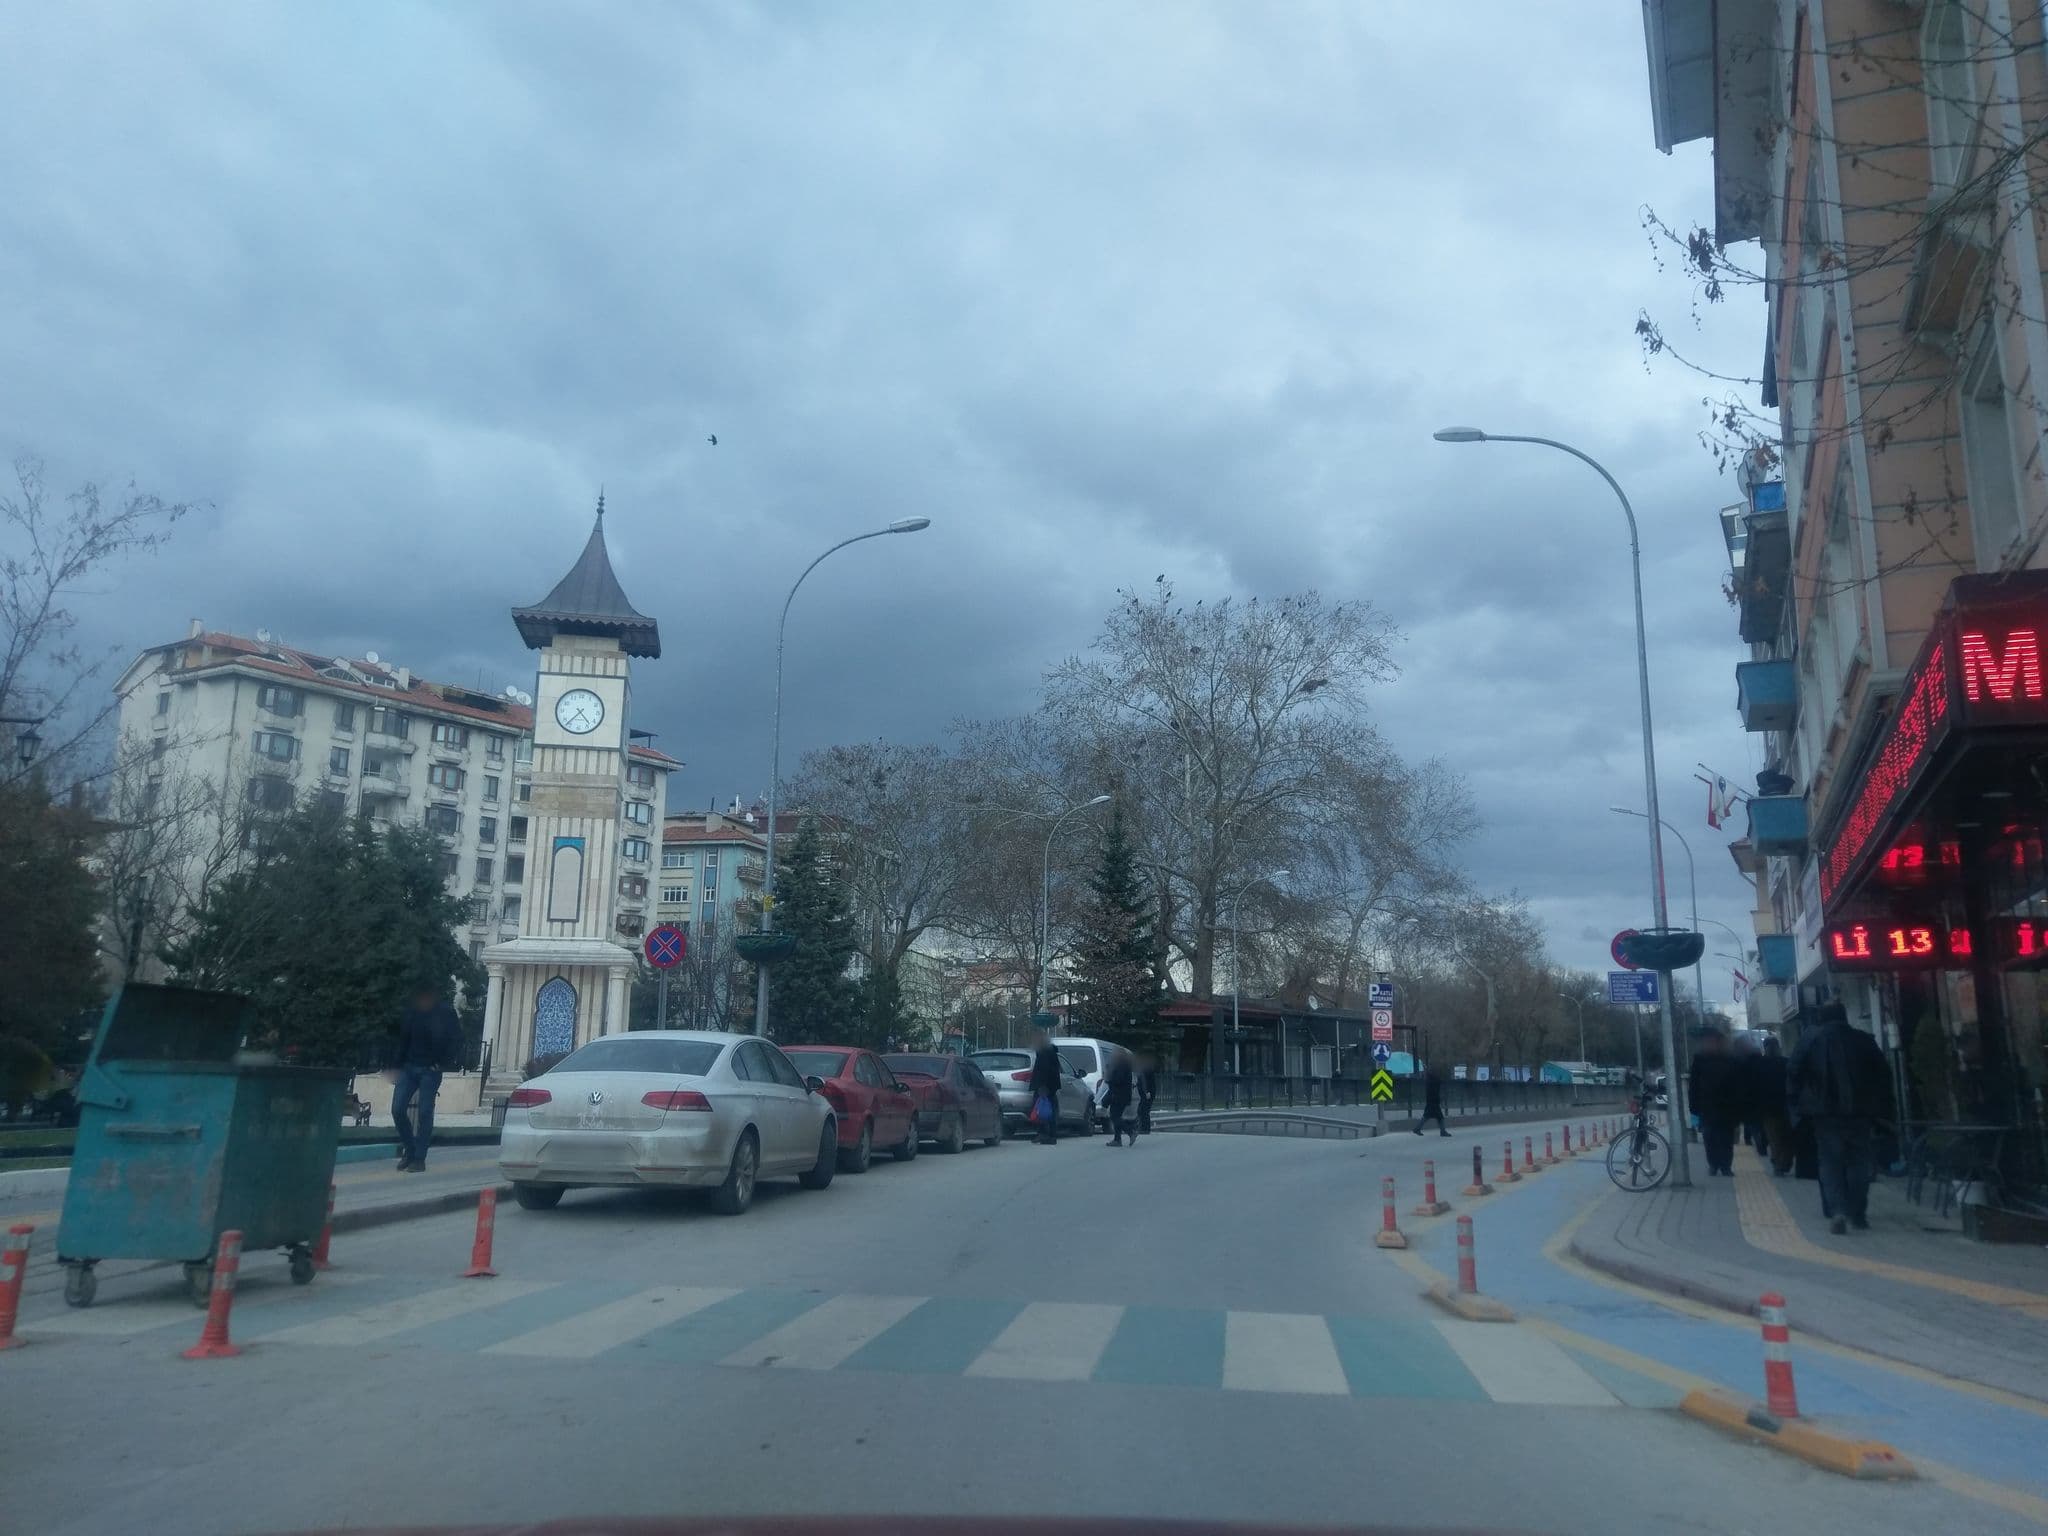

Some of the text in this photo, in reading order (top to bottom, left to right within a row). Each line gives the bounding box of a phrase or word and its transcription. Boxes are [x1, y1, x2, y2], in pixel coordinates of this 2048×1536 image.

[1962, 631, 2042, 700] M
[1889, 928, 1933, 955] 13
[1370, 984, 1380, 1001] P
